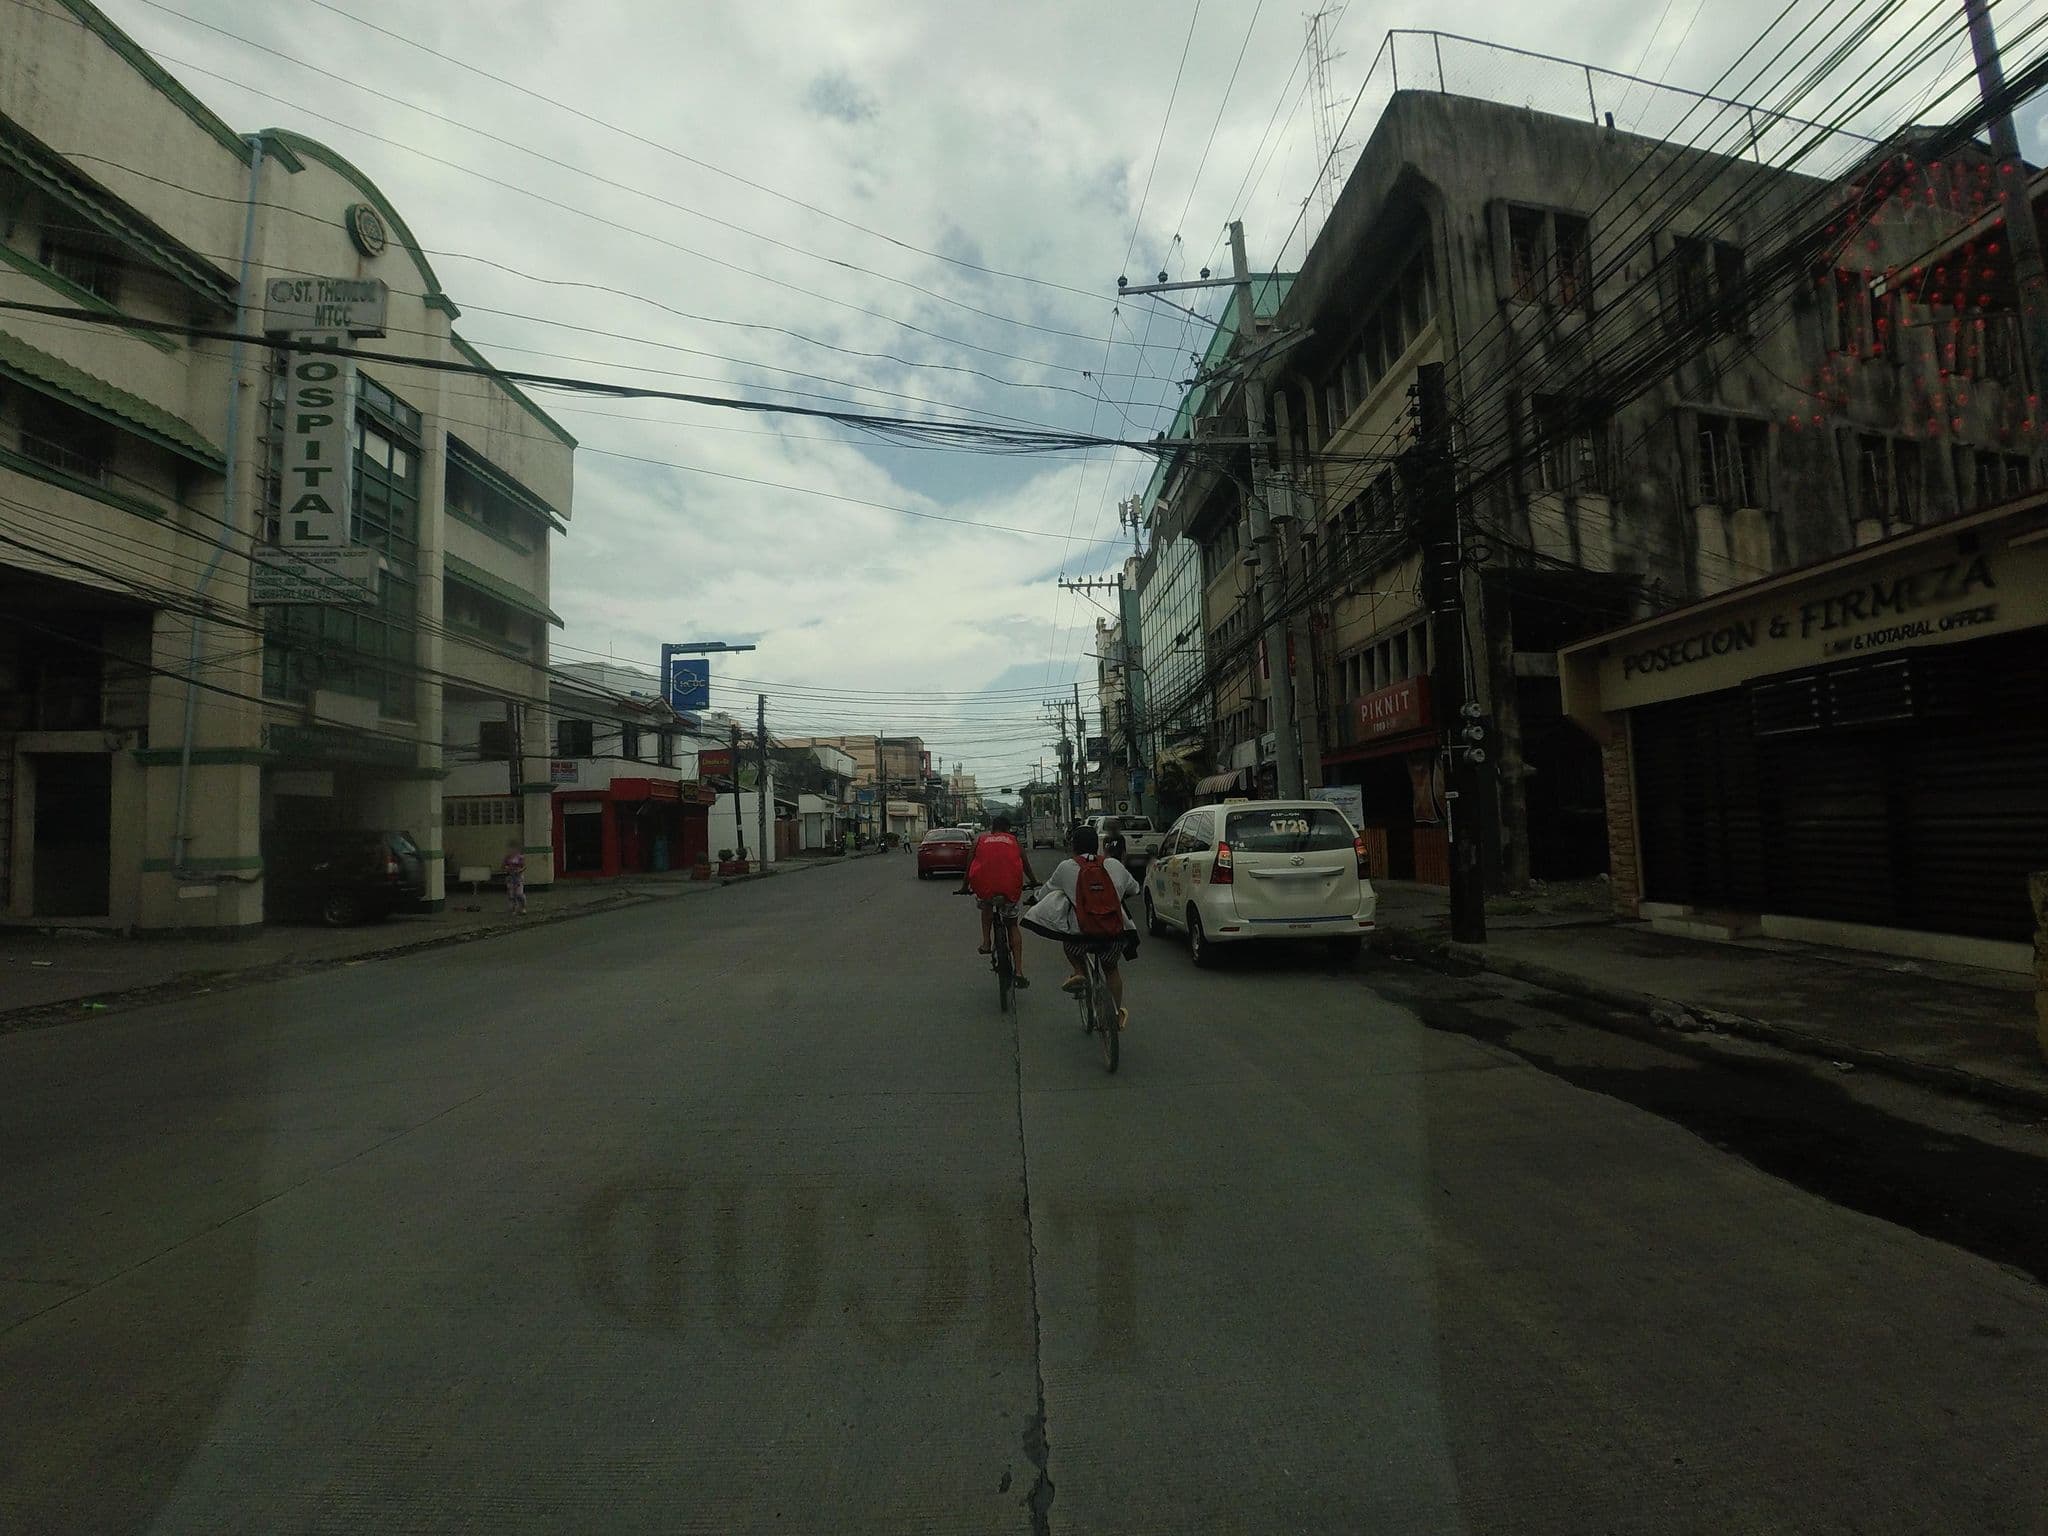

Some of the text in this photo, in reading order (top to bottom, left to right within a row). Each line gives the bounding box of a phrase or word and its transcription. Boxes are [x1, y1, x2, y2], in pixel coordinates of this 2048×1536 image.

[288, 336, 339, 541] HOSPITAL
[1769, 614, 1789, 640] &
[1853, 632, 1868, 650] &
[1867, 619, 1934, 648] NOTARIAL
[1361, 689, 1409, 723] PIKNIT
[1269, 819, 1310, 834] 1728
